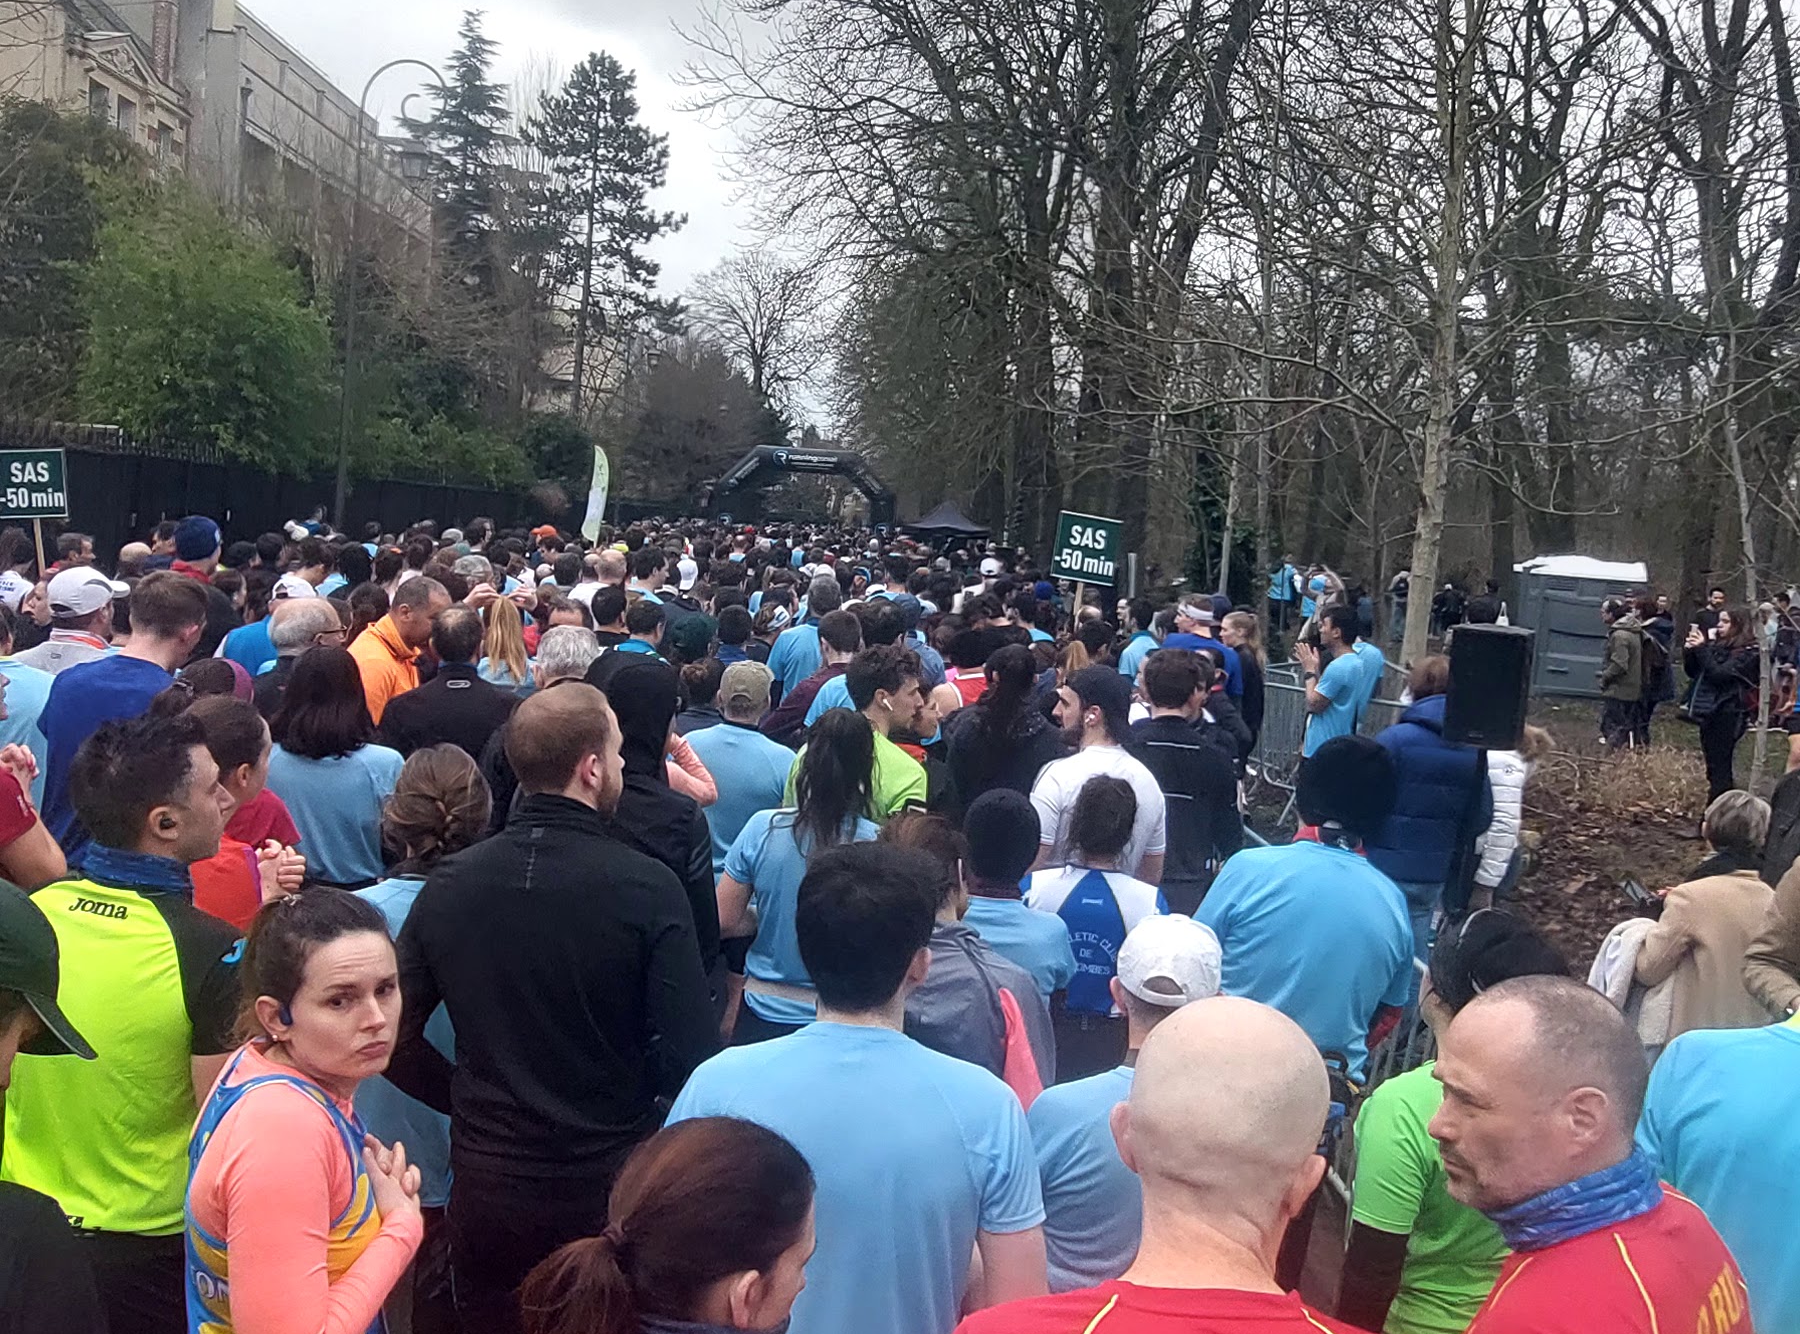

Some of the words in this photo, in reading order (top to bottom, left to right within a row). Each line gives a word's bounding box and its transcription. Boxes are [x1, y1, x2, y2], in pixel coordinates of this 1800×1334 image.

[10, 461, 50, 483] SAS
[0, 487, 29, 508] -50
[31, 487, 64, 507] min
[1069, 524, 1106, 549] SAS
[1054, 548, 1082, 571] -50
[1083, 555, 1114, 577] min
[1079, 948, 1093, 958] DE
